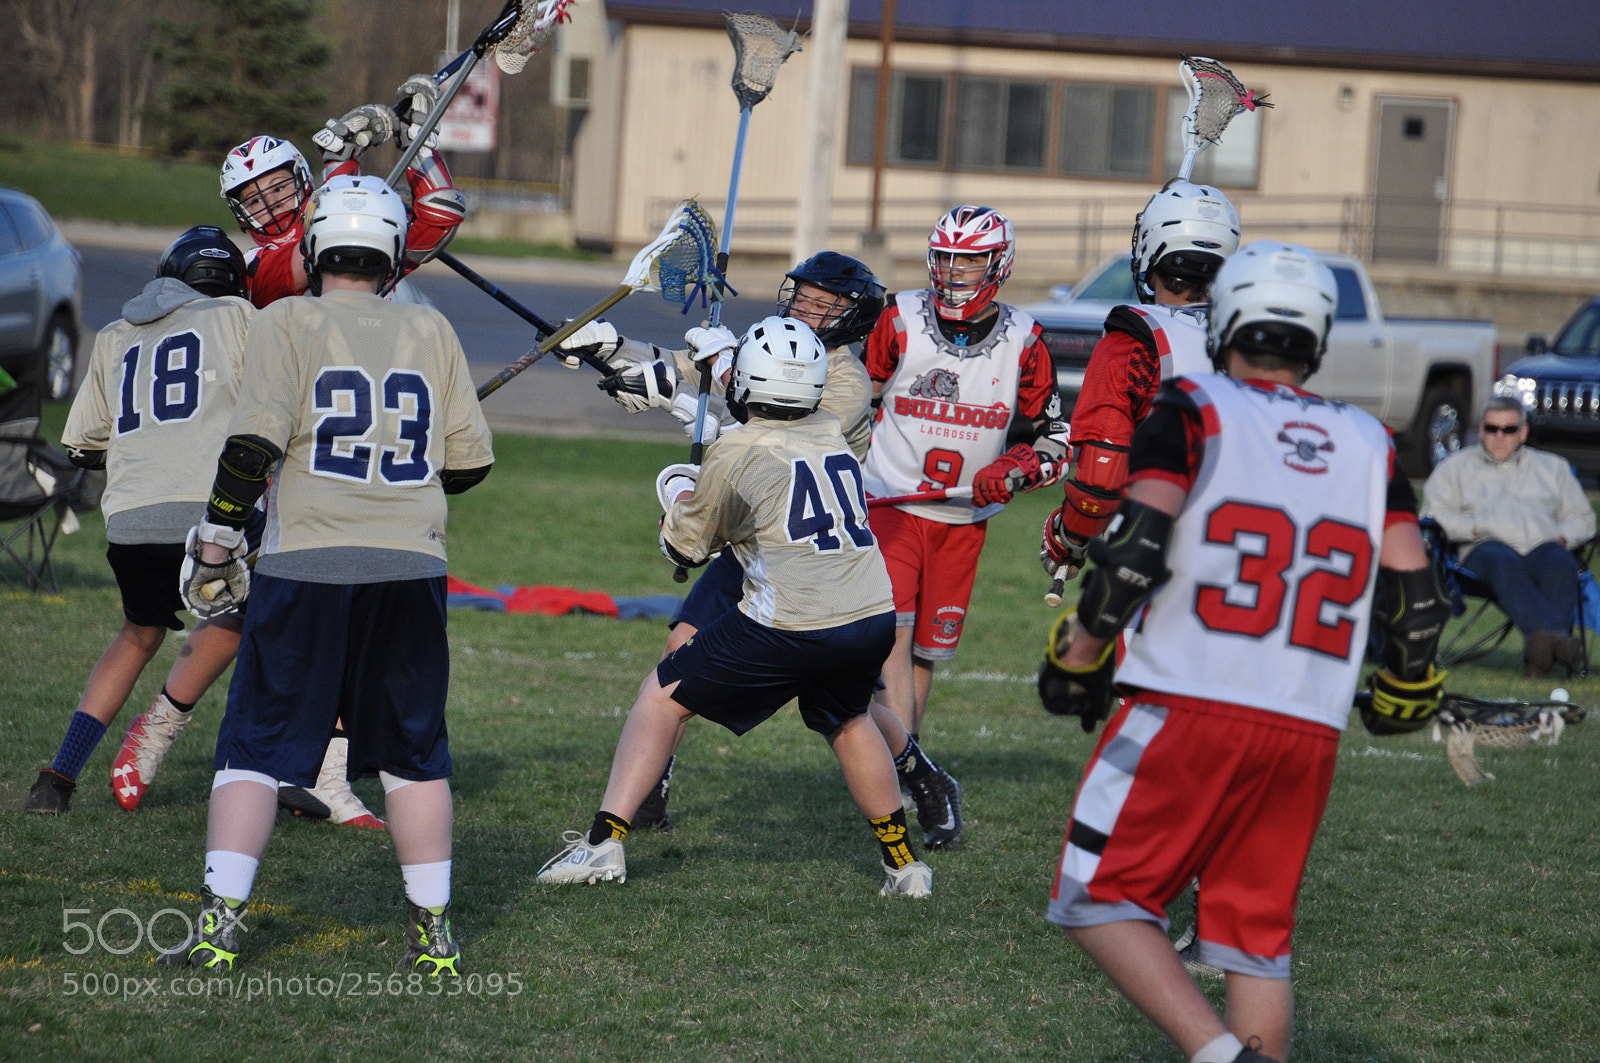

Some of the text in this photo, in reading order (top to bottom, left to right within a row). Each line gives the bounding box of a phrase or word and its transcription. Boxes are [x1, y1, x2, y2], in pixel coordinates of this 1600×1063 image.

[116, 328, 204, 438] 18
[309, 365, 434, 486] 23
[894, 395, 1010, 430] BULLDOGS
[920, 424, 979, 441] LACROSSE
[783, 449, 878, 554] 40
[916, 447, 965, 503] 9
[1190, 497, 1376, 662] 32
